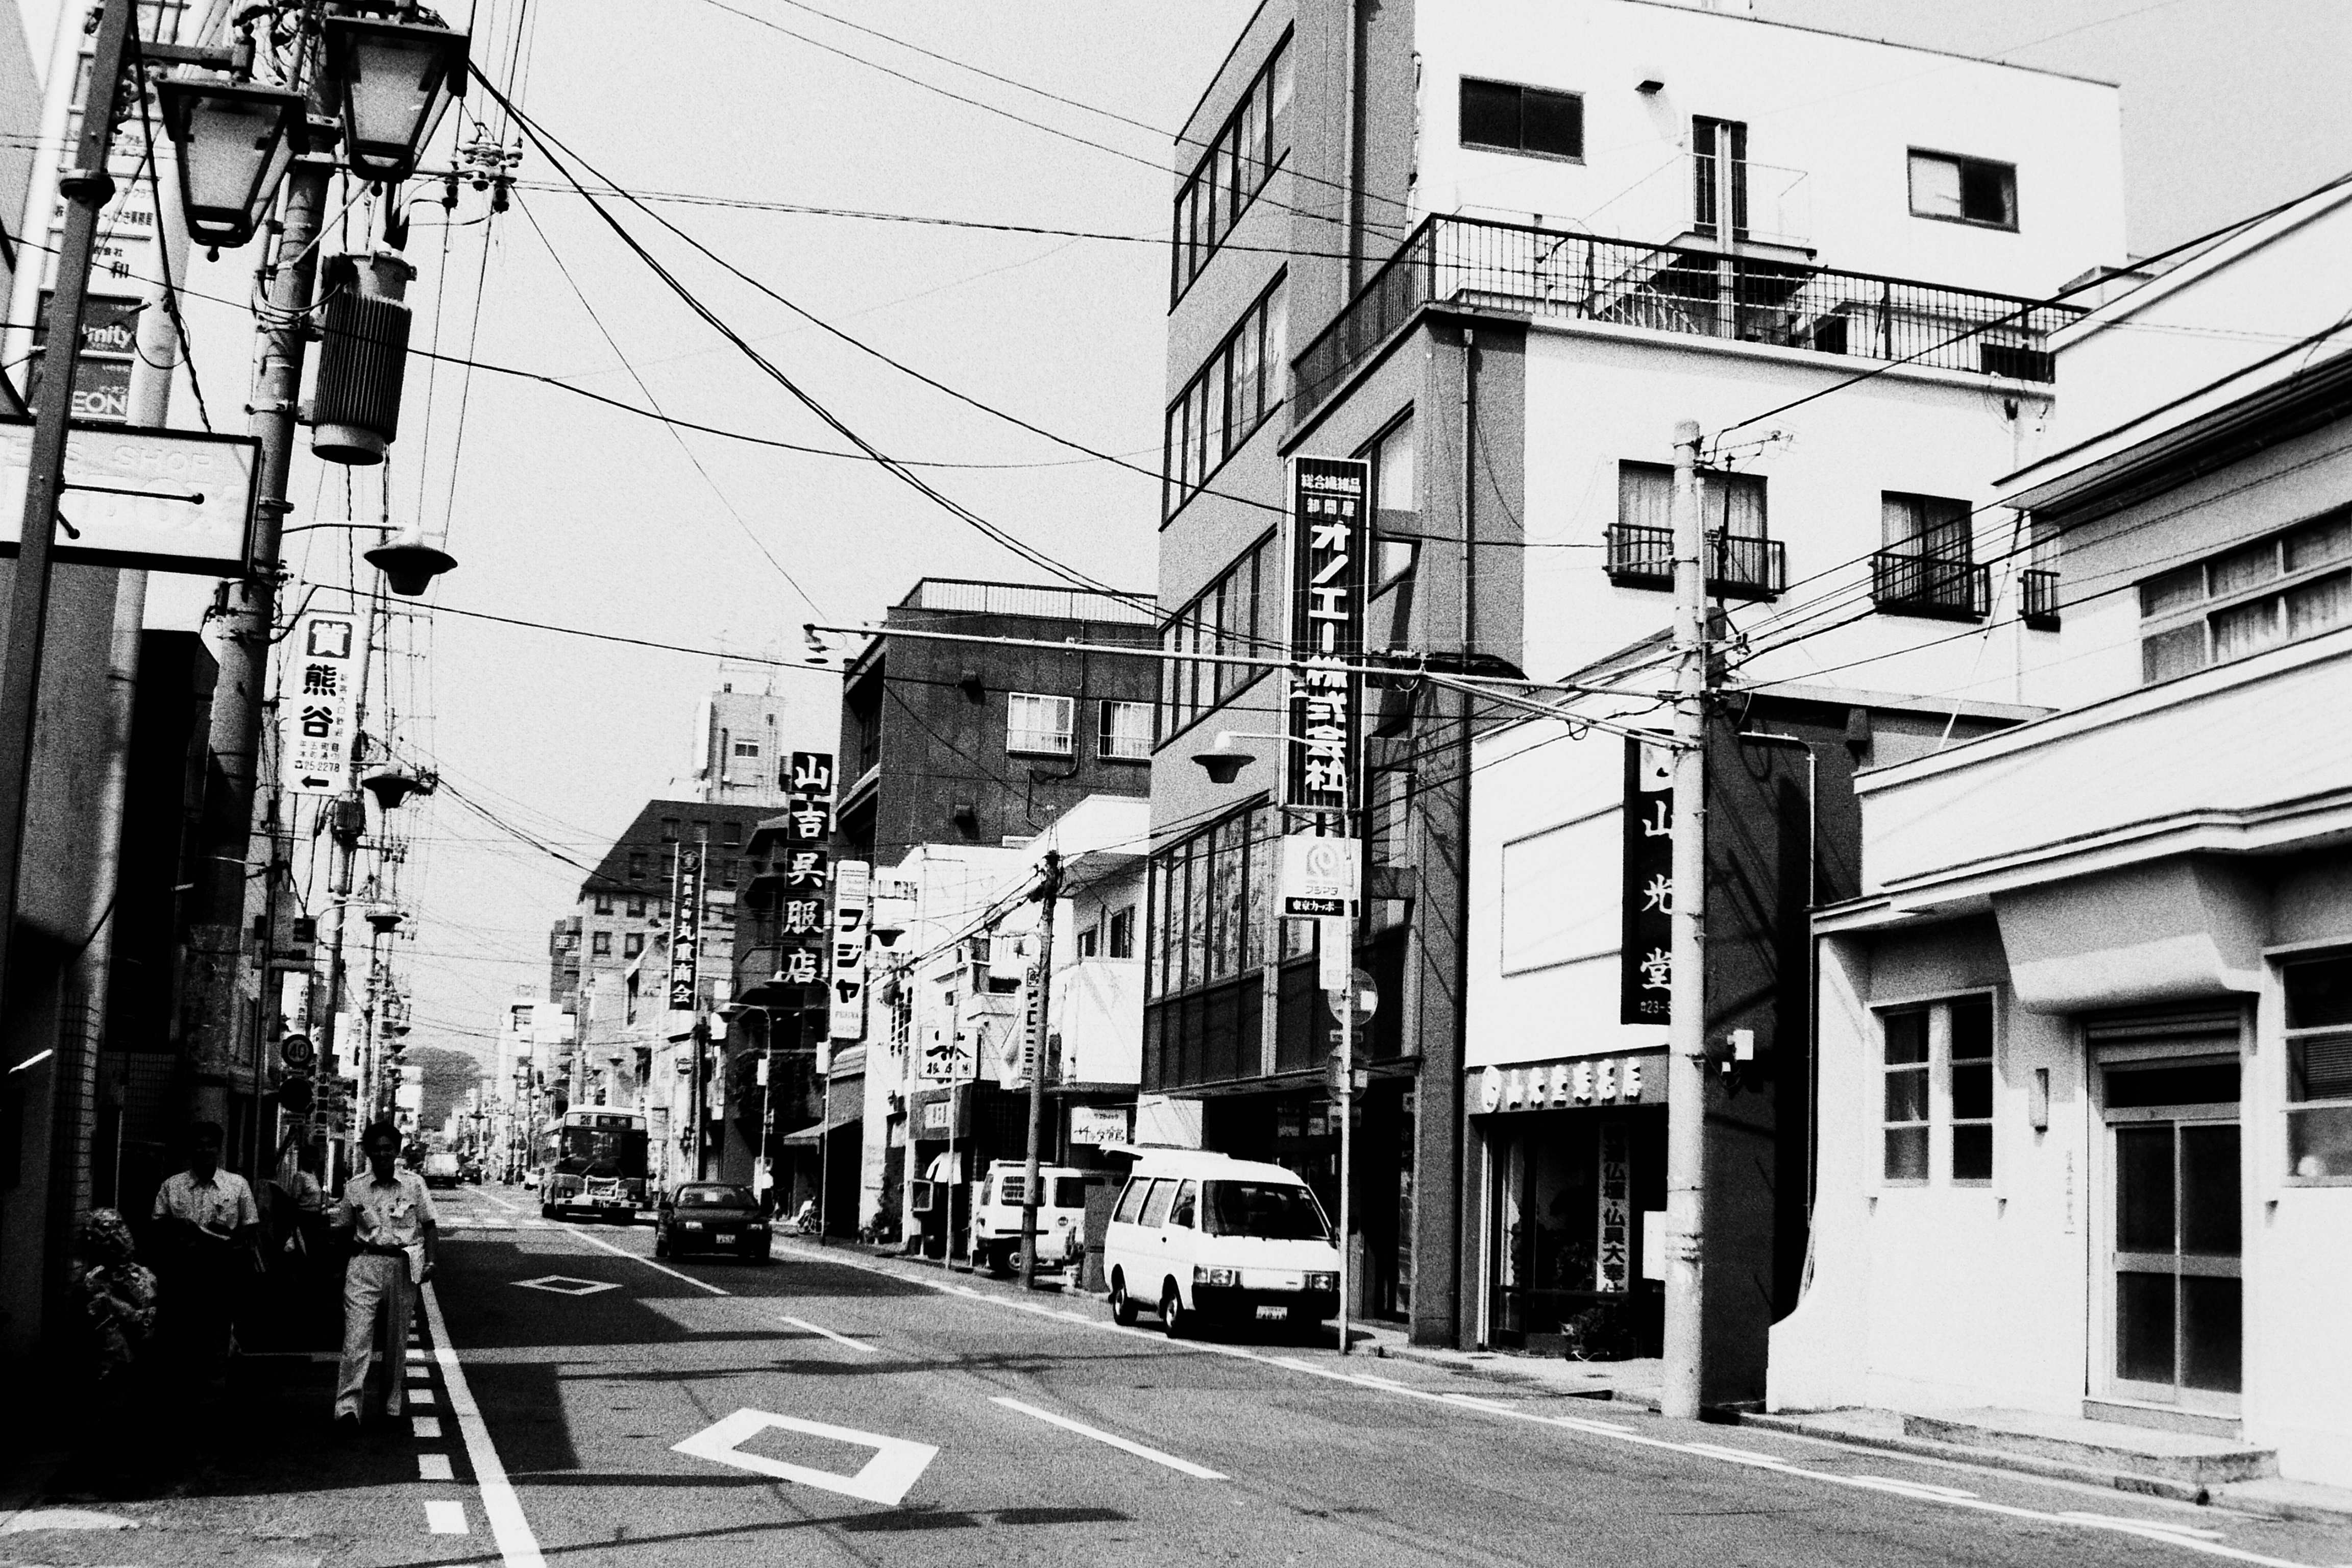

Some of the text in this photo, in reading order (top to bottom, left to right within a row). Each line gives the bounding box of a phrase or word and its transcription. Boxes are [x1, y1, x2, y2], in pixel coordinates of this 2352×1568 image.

[300, 663, 337, 738] 熊谷
[782, 755, 830, 985] 山吉呉服店
[288, 1043, 306, 1057] 40
